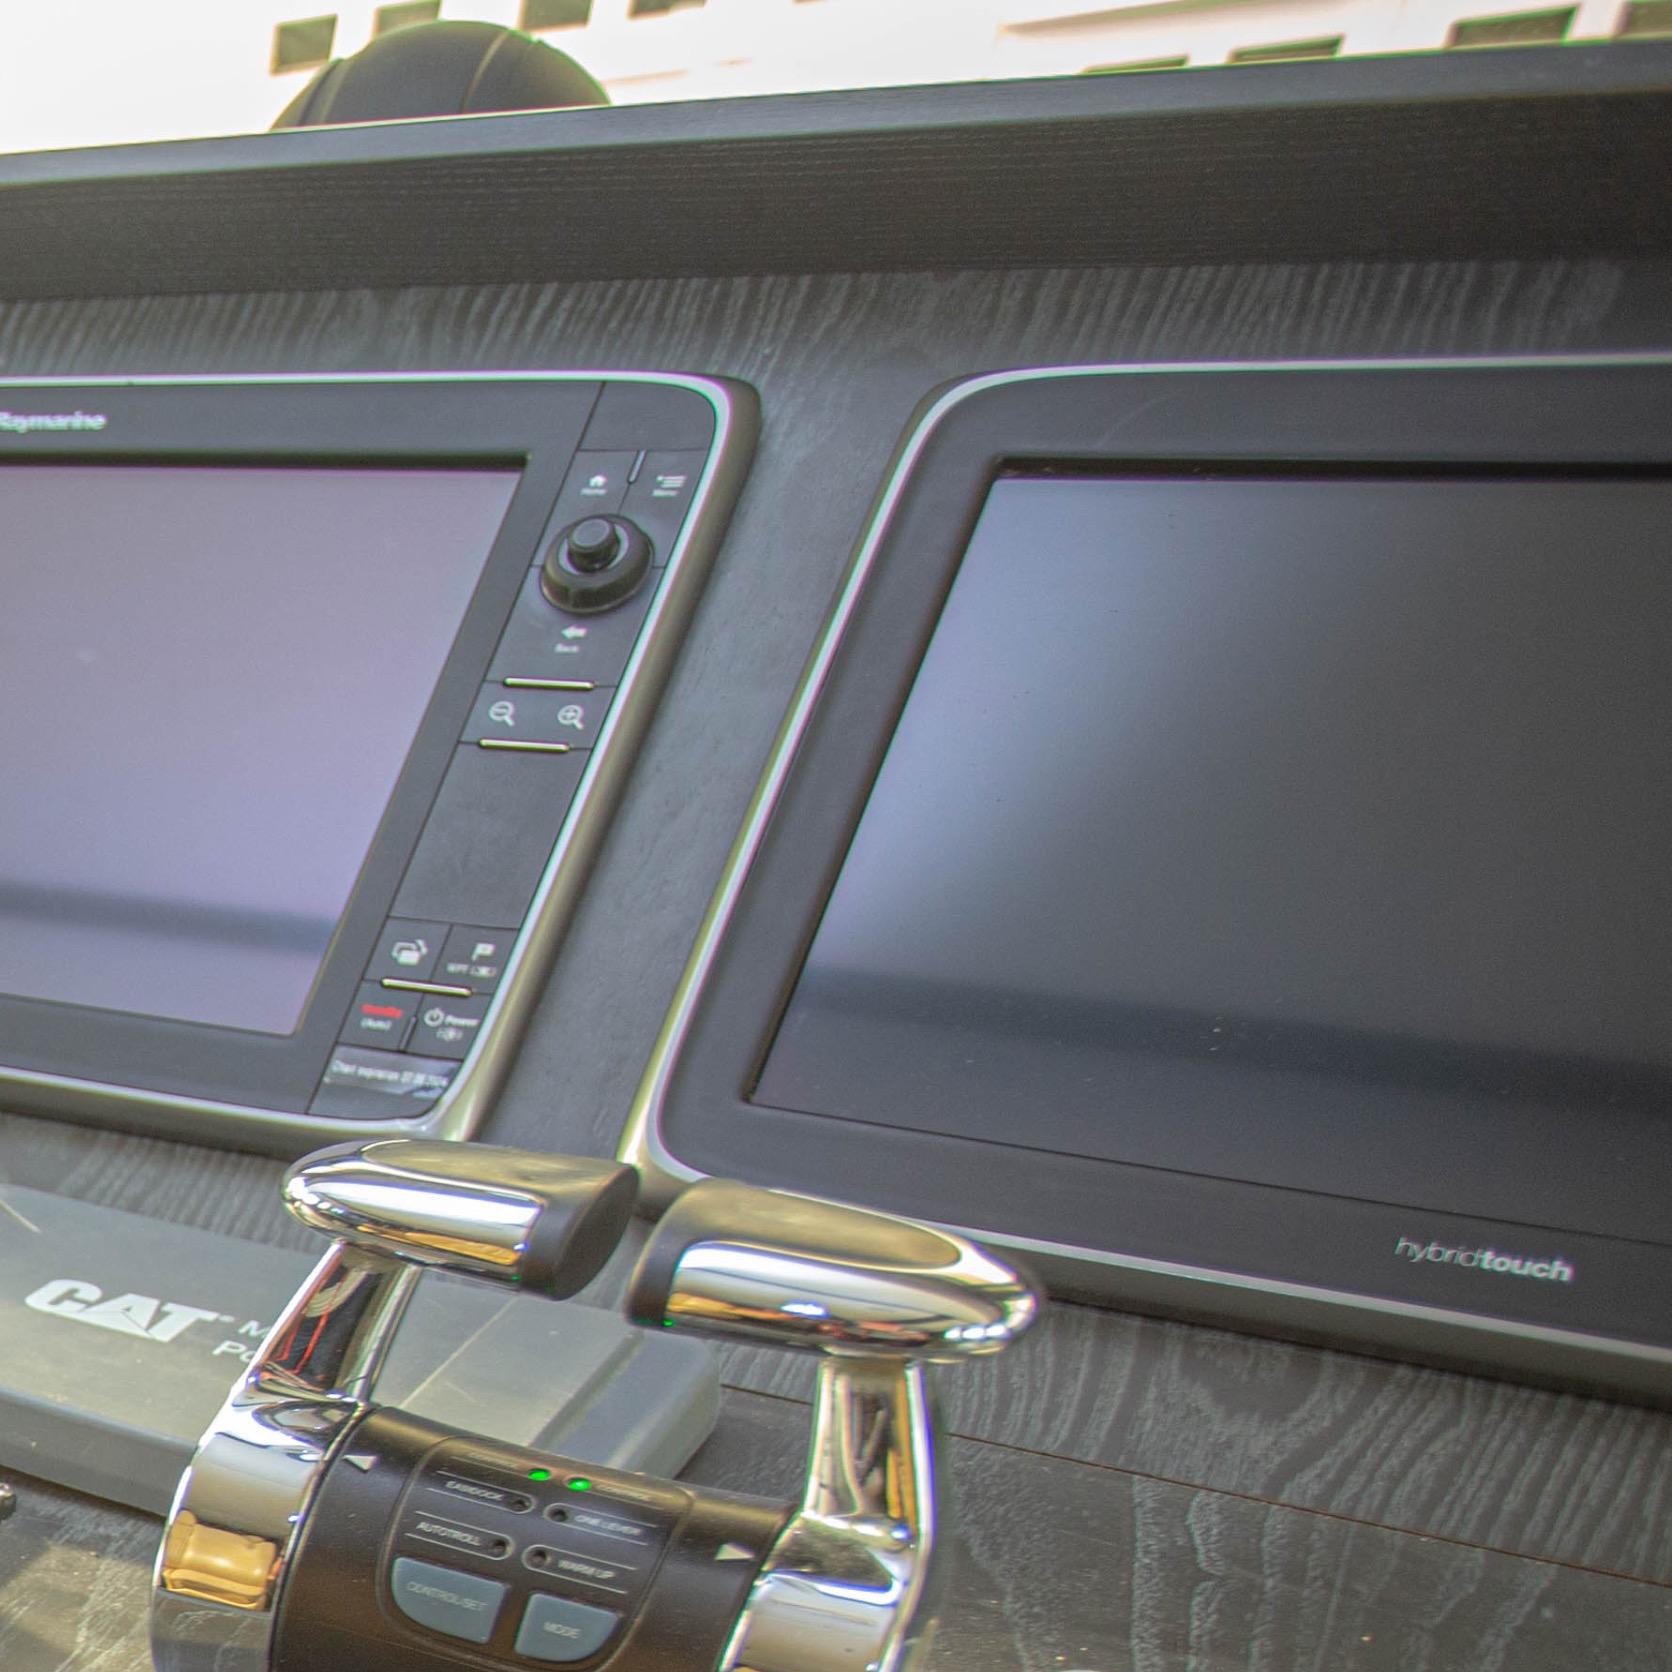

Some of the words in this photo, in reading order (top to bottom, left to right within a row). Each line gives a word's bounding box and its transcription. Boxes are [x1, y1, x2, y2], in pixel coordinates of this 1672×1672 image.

[1393, 1236, 1576, 1283] hybridtouch
[24, 1278, 220, 1343] CAT
[415, 1521, 482, 1548] AUTOTROLL
[543, 1620, 582, 1640] MODE
